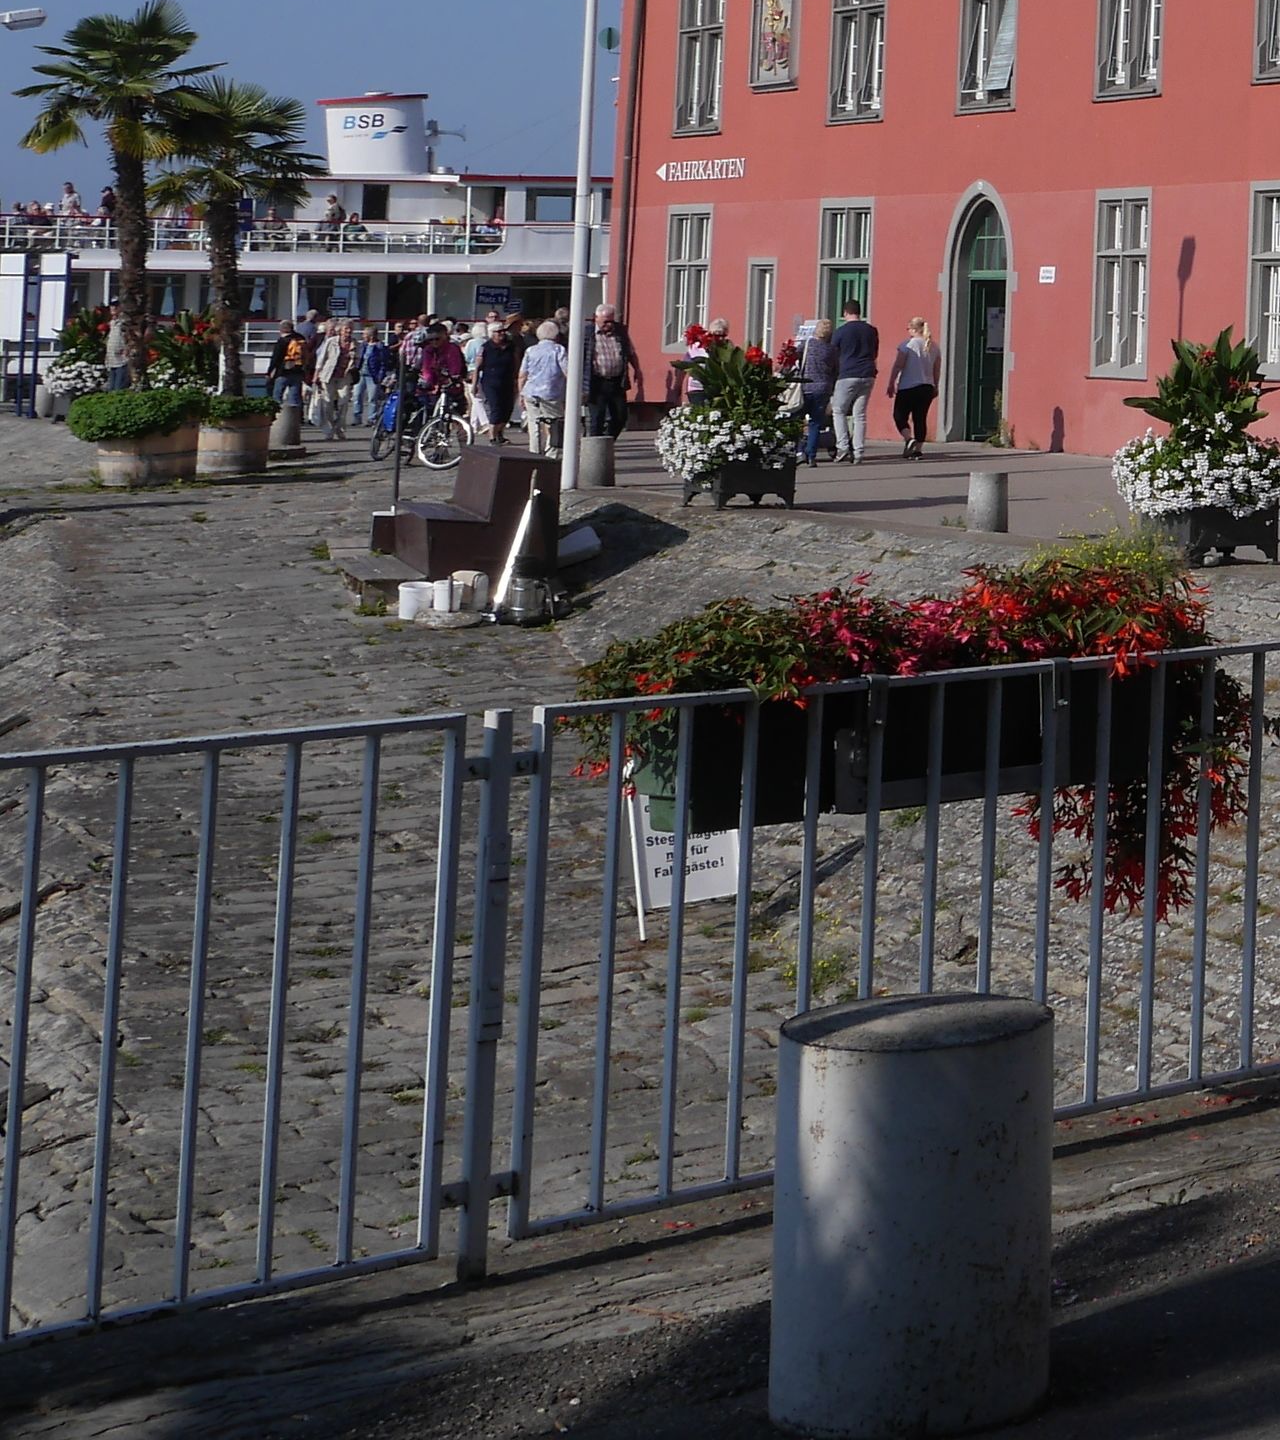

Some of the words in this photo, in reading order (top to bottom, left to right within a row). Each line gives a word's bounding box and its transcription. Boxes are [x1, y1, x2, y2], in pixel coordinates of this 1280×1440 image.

[343, 113, 385, 130] BSB
[668, 158, 746, 181] FAHRKARTEN
[690, 843, 710, 856] für
[654, 856, 725, 878] Fagäste!
